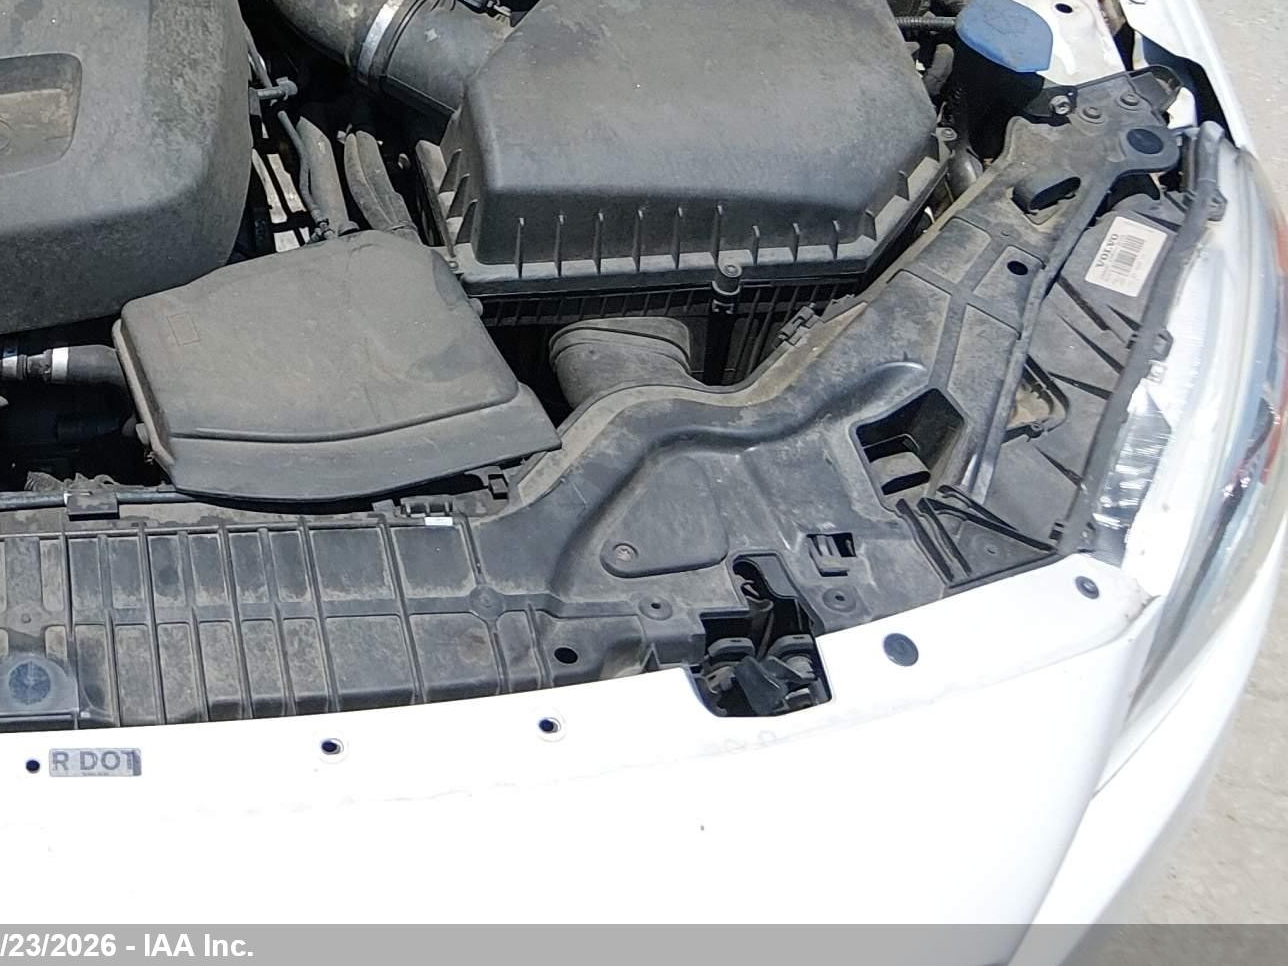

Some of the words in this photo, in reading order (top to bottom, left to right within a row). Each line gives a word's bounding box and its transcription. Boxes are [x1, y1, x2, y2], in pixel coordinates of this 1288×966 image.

[1096, 234, 1119, 267] VOLVO
[52, 751, 70, 772] R
[79, 750, 135, 772] DOT
